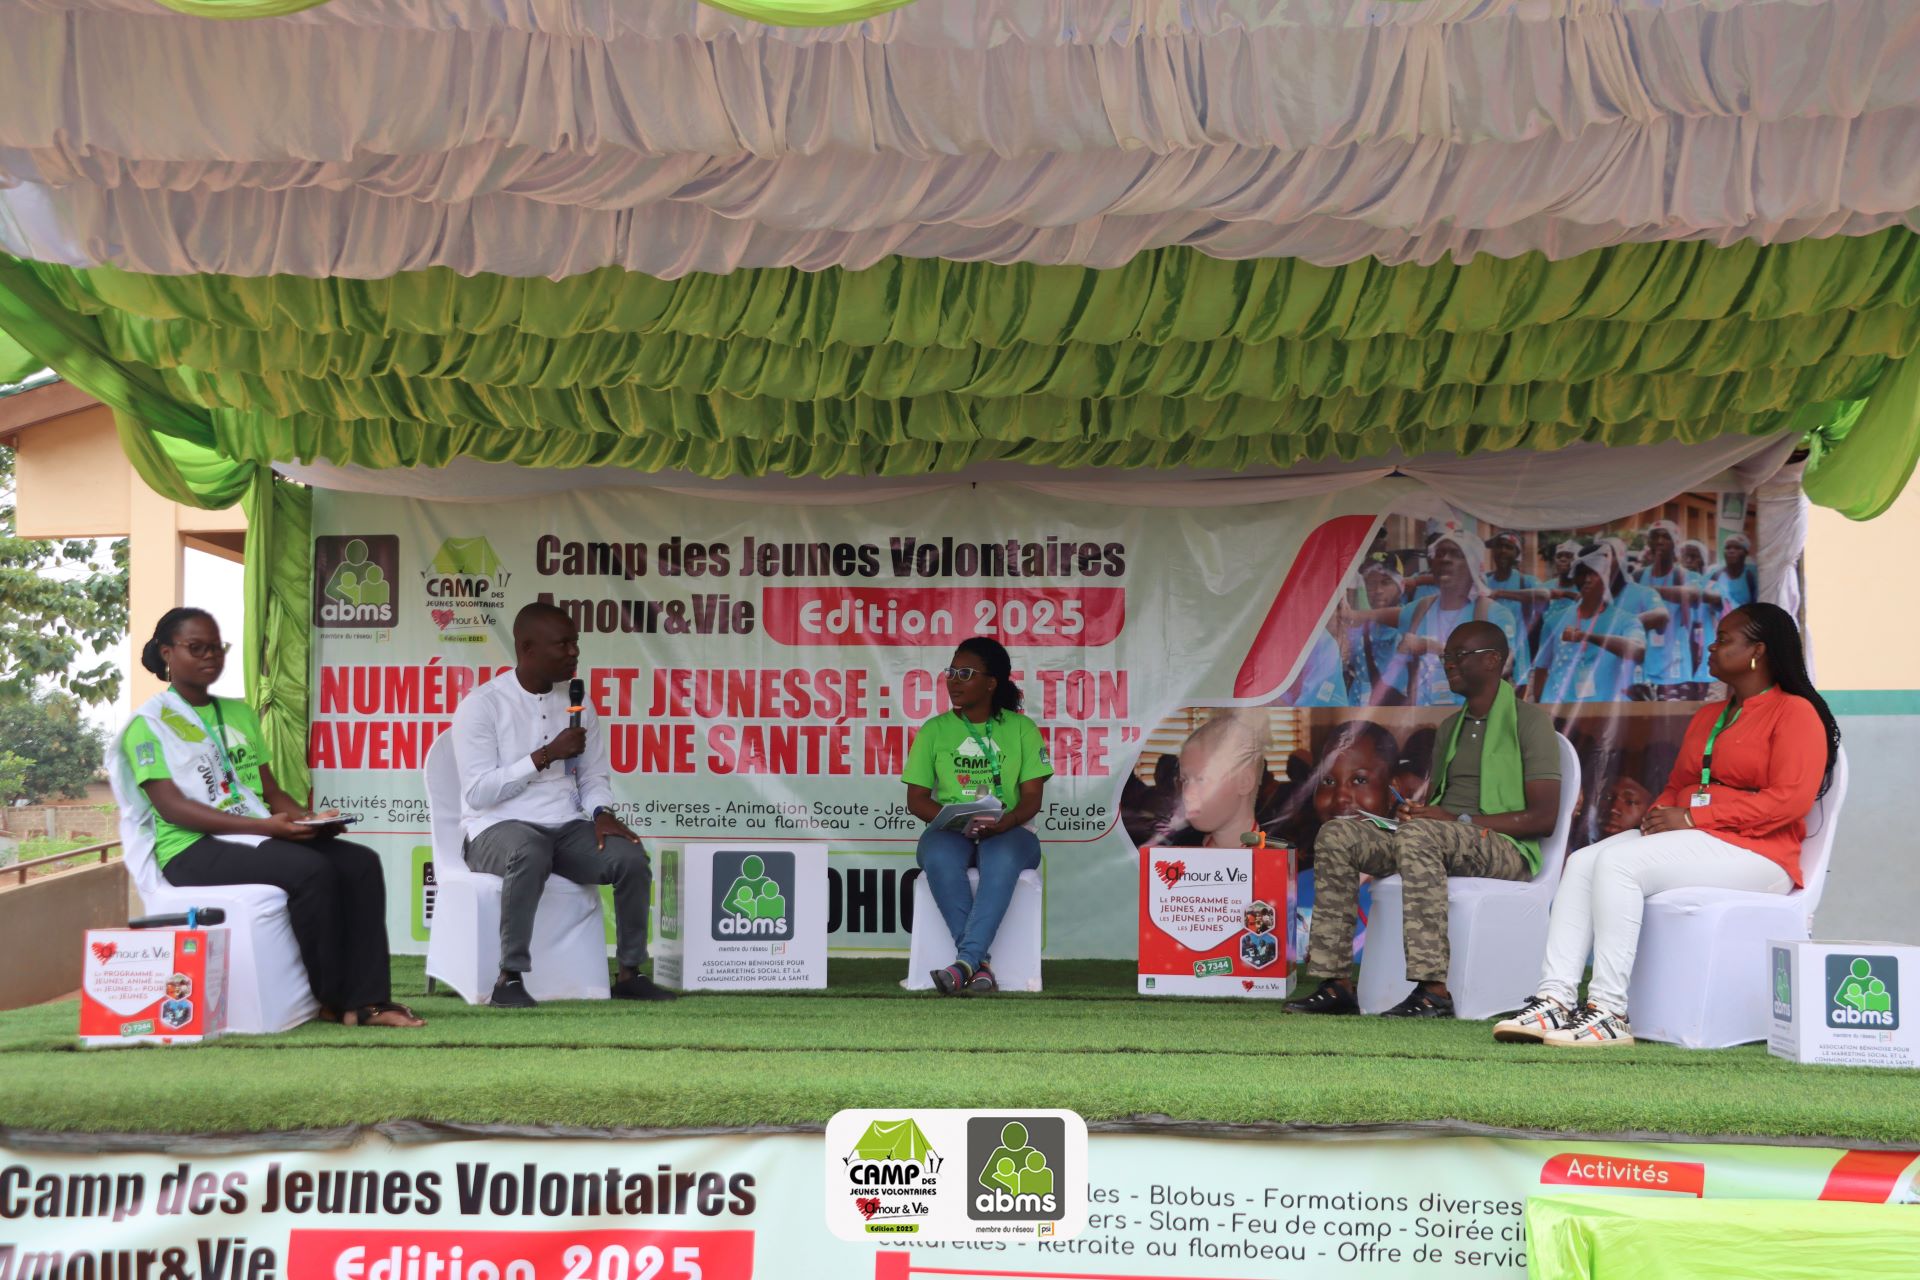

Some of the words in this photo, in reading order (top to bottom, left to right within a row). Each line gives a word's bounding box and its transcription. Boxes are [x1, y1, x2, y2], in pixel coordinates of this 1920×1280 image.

[536, 535, 647, 580] Camp
[658, 537, 730, 577] des
[739, 537, 880, 578] Jeunes
[889, 536, 1125, 578] Volontaires
[426, 578, 489, 597] CAMP
[320, 599, 392, 621] abms
[473, 615, 479, 624] &
[481, 614, 497, 625] Vie
[800, 600, 953, 634] Edition
[974, 599, 1085, 635] 2025
[320, 656, 513, 715] NUMÉR
[591, 668, 640, 717] ET
[649, 668, 867, 719] JEUNESSE
[880, 686, 890, 719] :
[1036, 669, 1129, 721] TON
[307, 721, 453, 769] AVENI
[611, 724, 697, 773] UNE
[707, 716, 851, 775] SANTÉ
[319, 795, 387, 809] Activités
[645, 800, 710, 813] diverses
[725, 801, 807, 815] Animation
[813, 802, 869, 815] Scoute
[1049, 803, 1079, 816] Feu
[1090, 803, 1106, 816] de
[676, 814, 737, 828] Retraite
[746, 817, 766, 828] au
[775, 816, 849, 830] flambeau
[874, 817, 916, 830] Offre
[1044, 818, 1106, 831] Cuisine
[1213, 870, 1224, 881] &
[1226, 868, 1248, 882] Vie
[1170, 896, 1229, 904] PROGRAMME
[718, 912, 788, 934] abms
[1190, 924, 1223, 932] JEUNES
[1217, 915, 1242, 923] POUR
[142, 949, 149, 958] &
[153, 946, 170, 959] Vie
[742, 945, 749, 953] du
[749, 959, 785, 967] BÉNINOISE
[1207, 961, 1229, 971] 7344
[789, 974, 810, 982] SANTÉ
[1831, 1005, 1894, 1025] abms
[1567, 1158, 1669, 1185] Activités
[0, 1164, 146, 1222] Camp
[157, 1162, 249, 1215] des
[262, 1162, 442, 1215] Jeunes
[456, 1162, 756, 1217] Volontaires
[1150, 1185, 1235, 1208] Blobus
[1264, 1187, 1409, 1212] Formations
[1419, 1193, 1523, 1217] diverses
[1149, 1211, 1209, 1234] Slam
[1232, 1213, 1277, 1234] Feu
[1286, 1215, 1317, 1235] de
[1323, 1220, 1392, 1242] camp
[1414, 1217, 1494, 1242] Soirée
[334, 1245, 536, 1280] Edition
[562, 1244, 704, 1280] 2025
[1146, 1241, 1177, 1257] au
[1188, 1237, 1305, 1261] flambeau
[1337, 1241, 1402, 1263] Offre
[1413, 1243, 1443, 1263] de
[1454, 1247, 1528, 1268] servic
